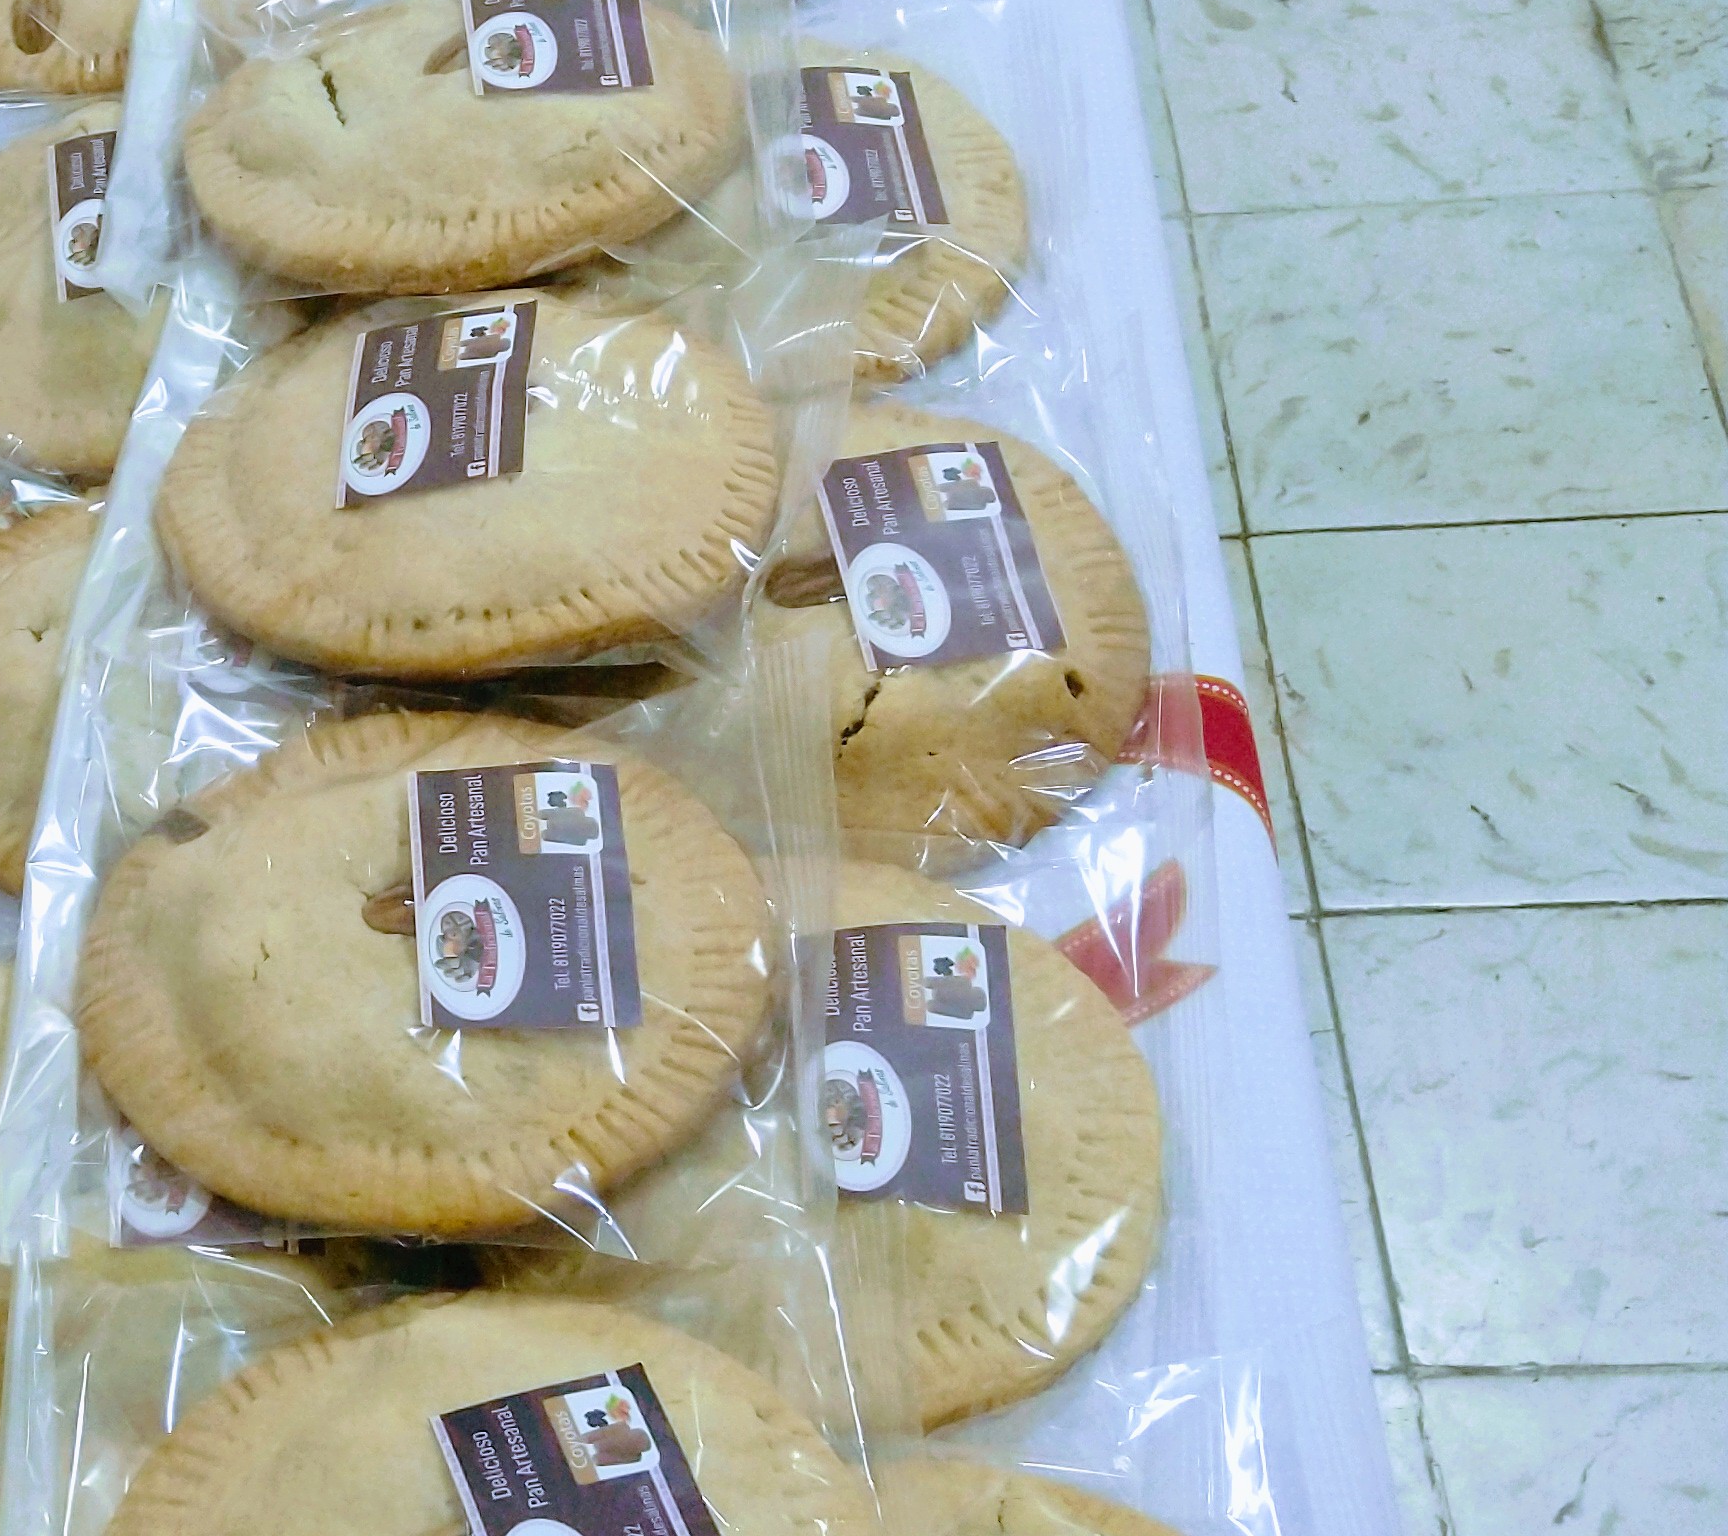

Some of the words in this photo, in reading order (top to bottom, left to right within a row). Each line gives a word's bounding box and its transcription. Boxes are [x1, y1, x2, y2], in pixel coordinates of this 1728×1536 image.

[371, 341, 392, 383] Delicioso
[399, 325, 418, 367] Artesanal
[395, 369, 413, 387] Pan
[841, 477, 870, 526] Delicioso
[861, 461, 894, 512] Artesanal
[882, 513, 900, 534] Pan
[438, 793, 458, 854] Delicioso
[462, 774, 487, 838] Artesanal
[519, 786, 540, 840] Coyotas
[468, 840, 489, 866] Pan
[548, 898, 568, 968] 8119077022
[846, 933, 871, 1001] Artesanal
[905, 949, 925, 1009] Coyotas
[852, 1004, 873, 1032] Pan
[934, 1073, 955, 1141] 8119077022
[472, 1431, 513, 1499] Delicioso
[492, 1405, 542, 1476] Artesanal
[555, 1410, 588, 1469] Coyotas
[527, 1477, 550, 1508] Pan
